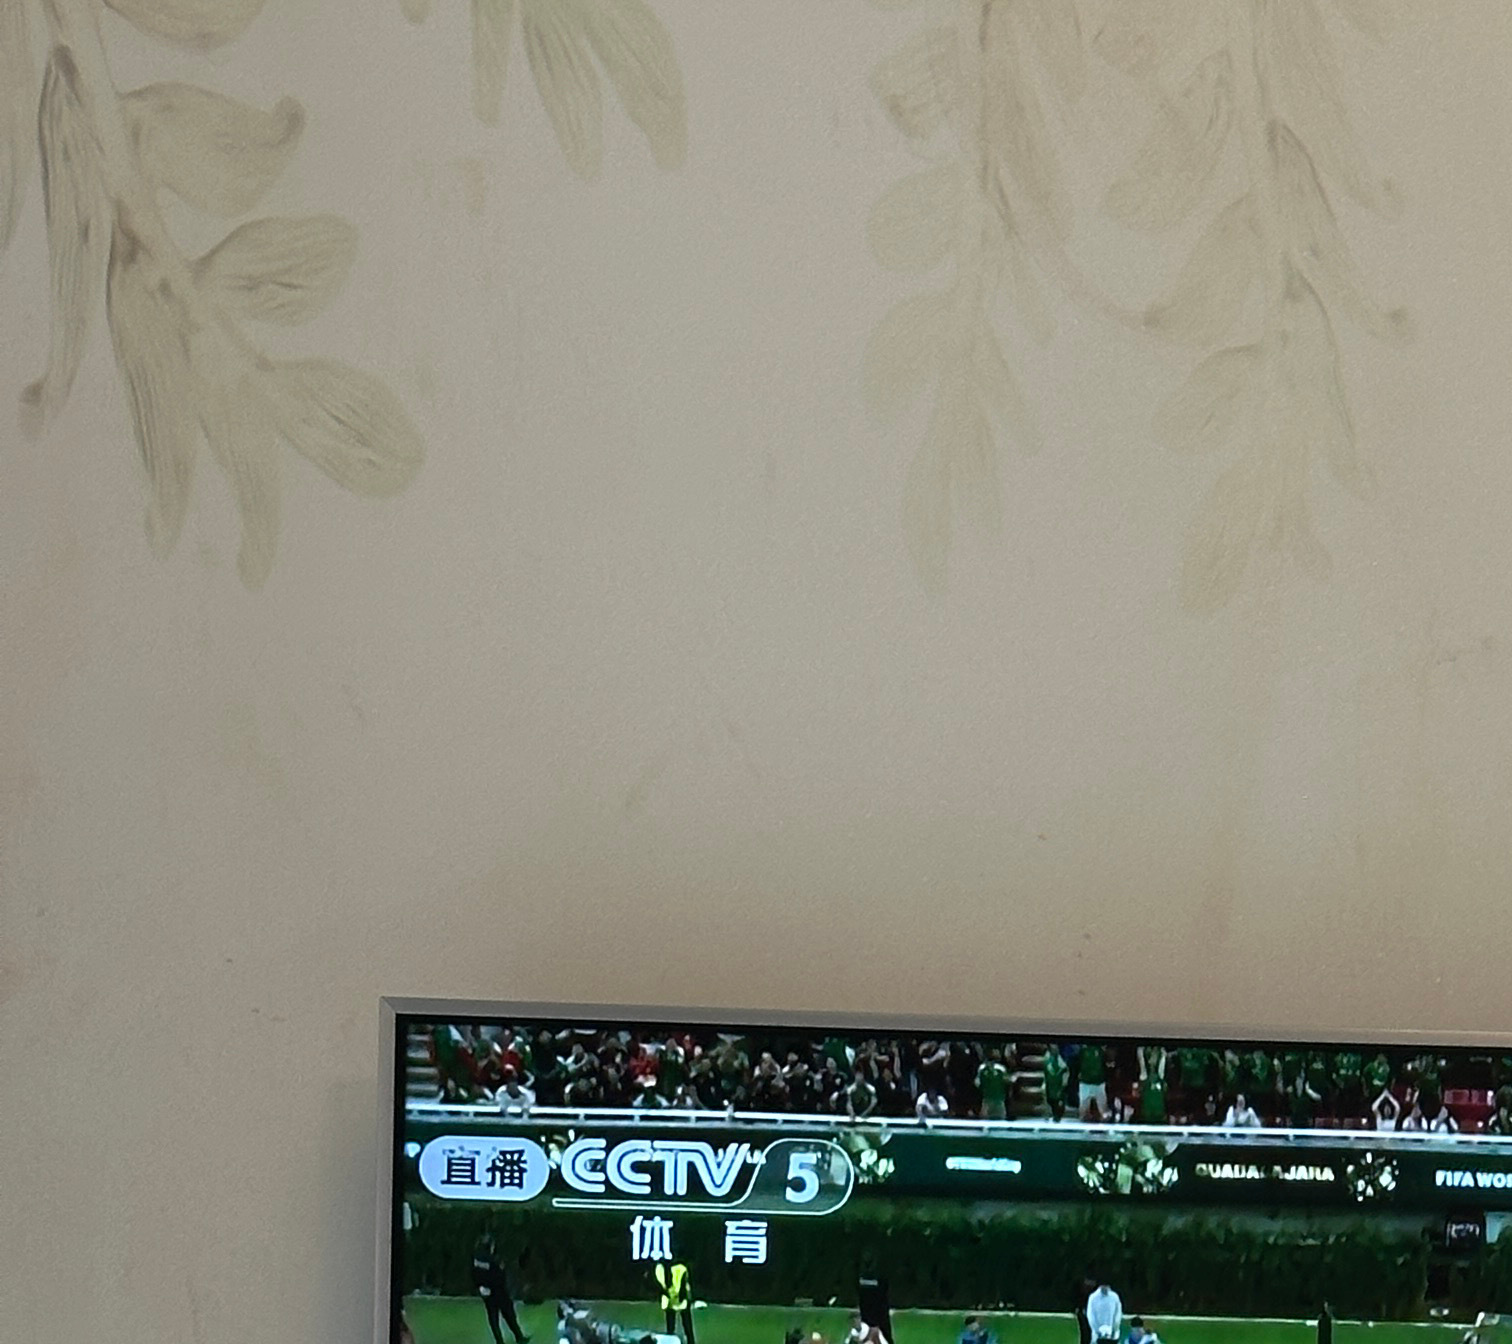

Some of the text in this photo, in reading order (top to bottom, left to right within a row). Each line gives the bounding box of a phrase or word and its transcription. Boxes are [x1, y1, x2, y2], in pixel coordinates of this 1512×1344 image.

[440, 1146, 528, 1190] 直播
[560, 1137, 821, 1203] CCTV 5
[1434, 1169, 1475, 1189] FIFA
[629, 1214, 769, 1264] 体育
